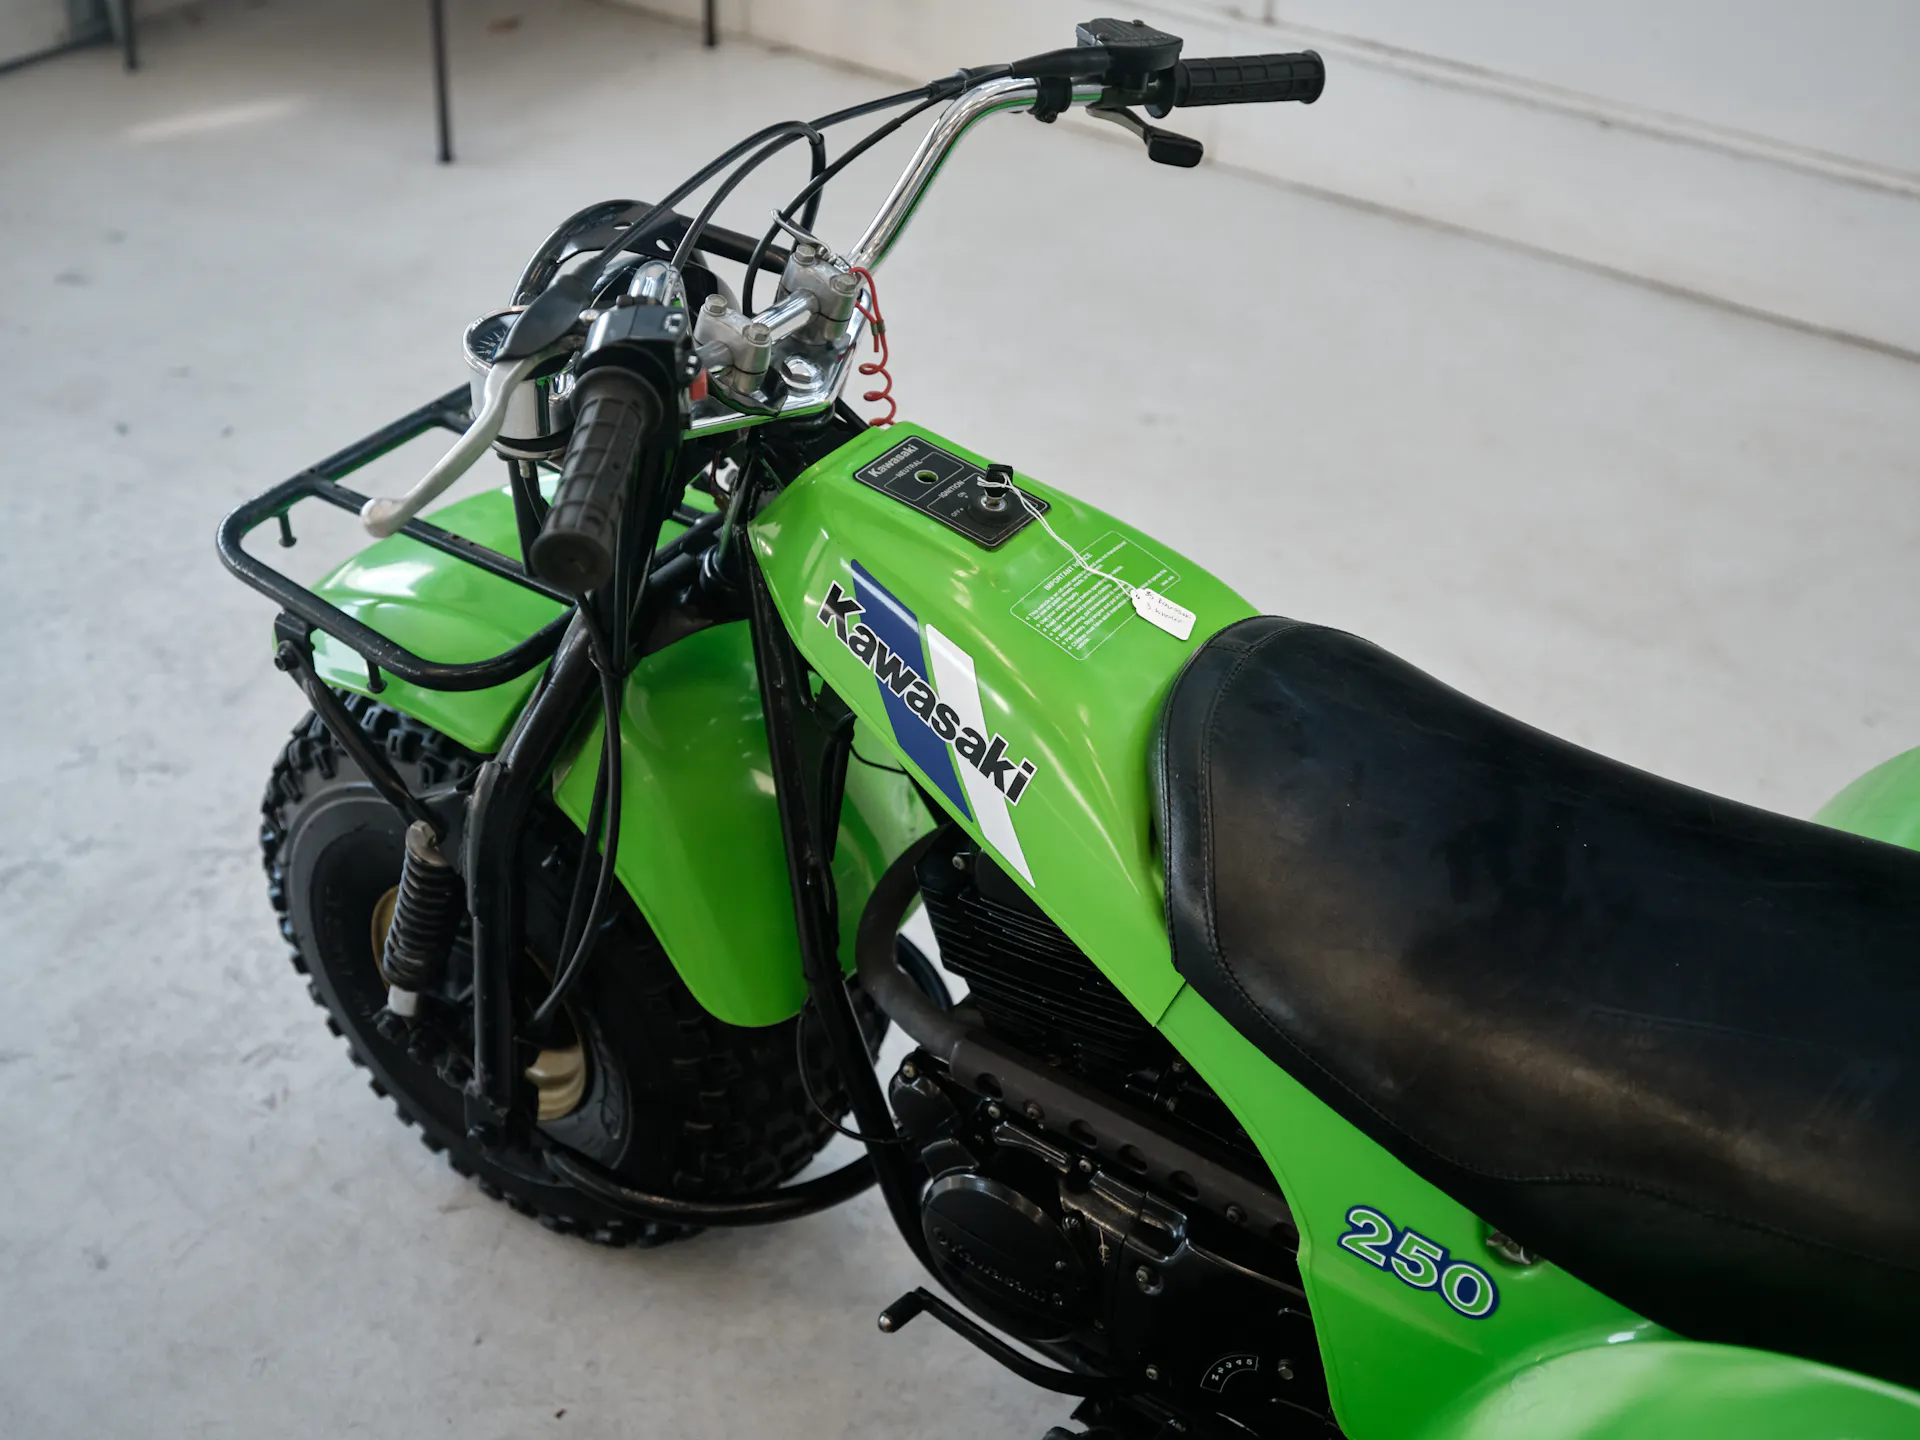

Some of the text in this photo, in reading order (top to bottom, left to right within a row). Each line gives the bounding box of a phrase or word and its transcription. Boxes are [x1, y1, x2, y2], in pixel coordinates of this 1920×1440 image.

[868, 444, 919, 478] Kawasaki
[895, 460, 923, 478] NEUTRAL
[938, 480, 965, 498] IGNITION
[1074, 552, 1093, 572] NOCE
[817, 580, 1038, 806] Kawasaki
[1337, 1205, 1500, 1320] 250
[1217, 1366, 1225, 1375] 2
[1225, 1361, 1233, 1369] 3
